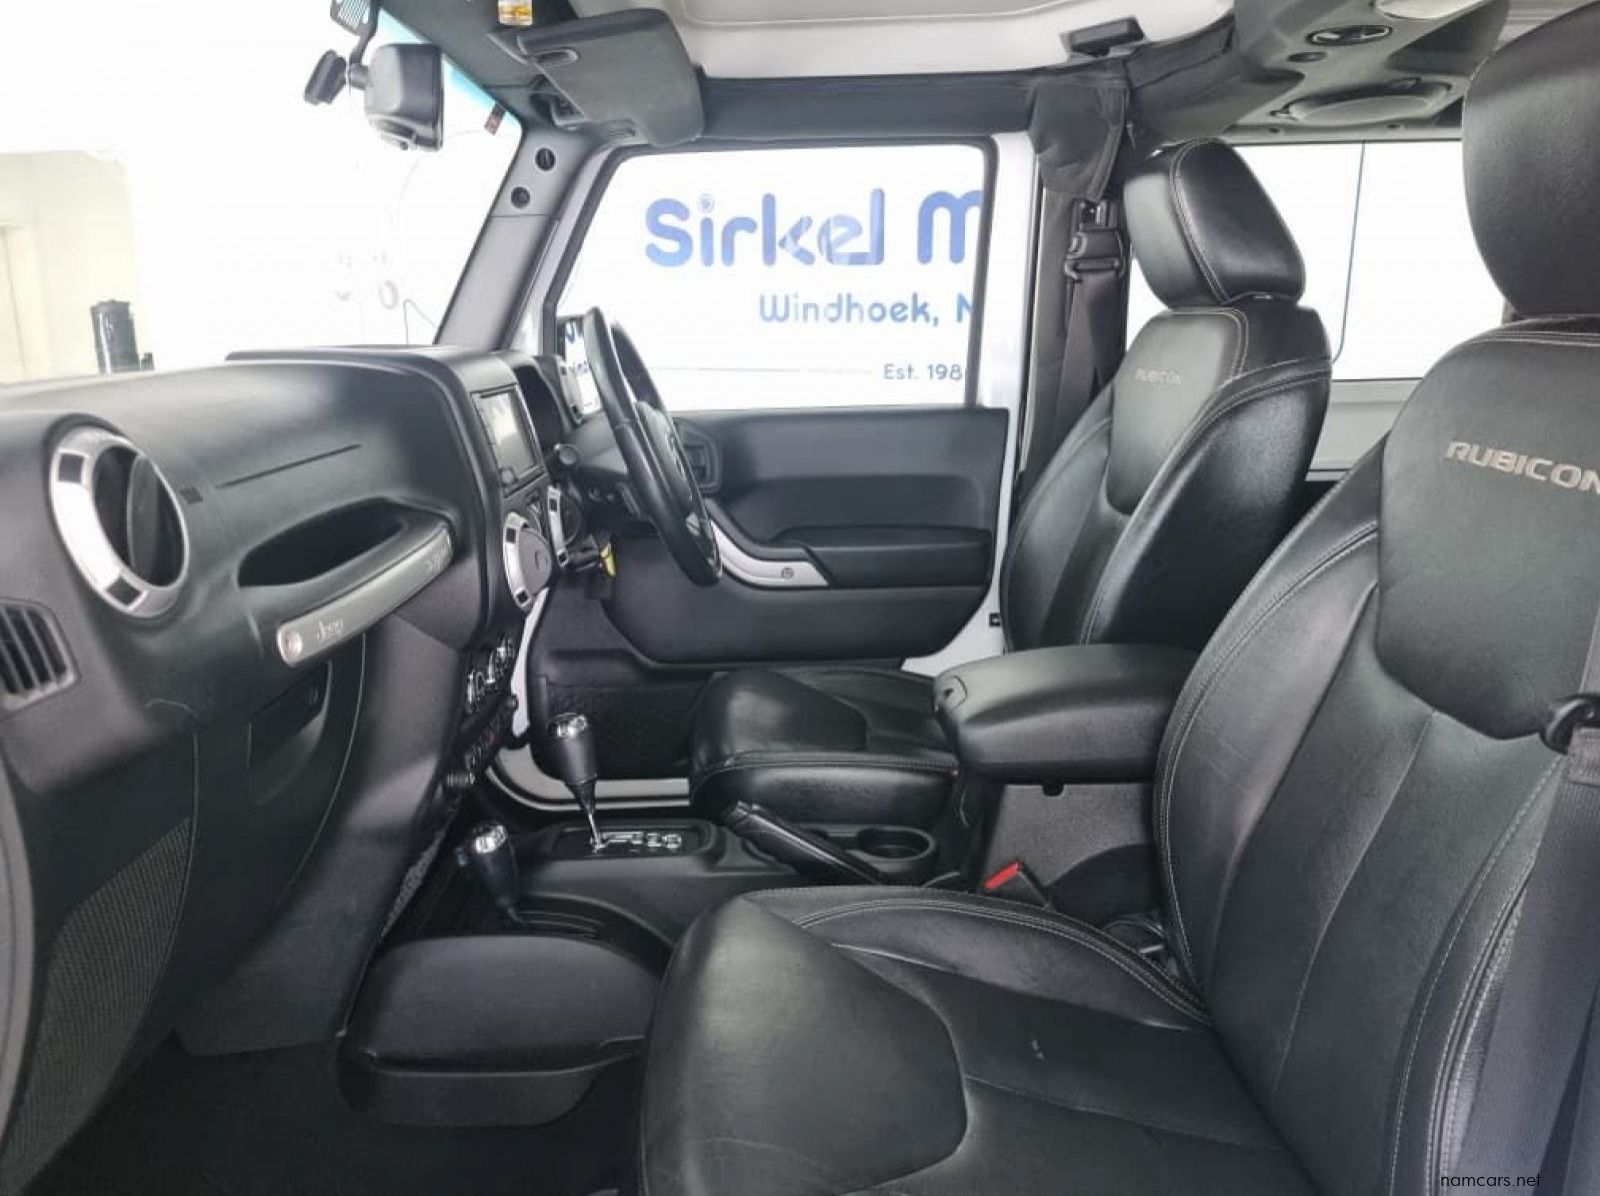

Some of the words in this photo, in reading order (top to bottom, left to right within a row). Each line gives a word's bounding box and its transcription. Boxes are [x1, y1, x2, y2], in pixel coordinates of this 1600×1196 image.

[645, 187, 885, 268] Sirkel
[759, 292, 939, 328] Windhoek,
[883, 363, 918, 381] Est.
[1445, 440, 1600, 495] RUBICON
